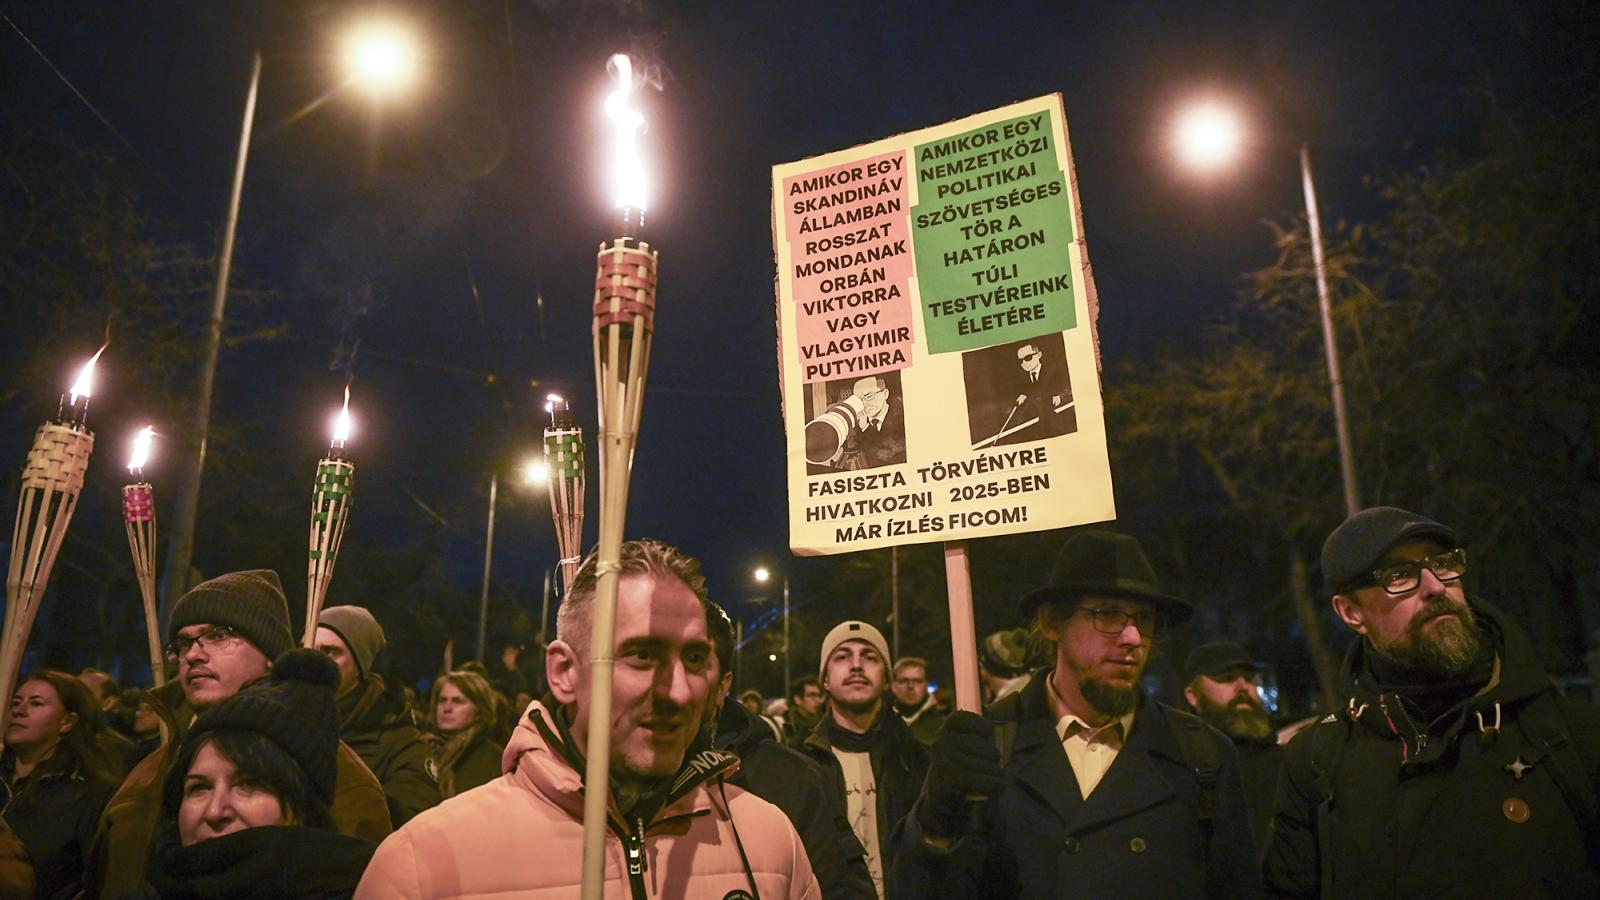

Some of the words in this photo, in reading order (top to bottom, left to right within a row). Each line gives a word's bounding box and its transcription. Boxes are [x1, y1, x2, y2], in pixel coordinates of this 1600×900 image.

[921, 129, 999, 162] AMIKOR
[1003, 115, 1042, 140] EGY
[790, 168, 863, 196] AMIKOR
[867, 156, 903, 177] EGY
[921, 136, 1048, 182] NEMZETKÖZI
[794, 177, 902, 214] SKANDINÁV
[938, 162, 1036, 198] POLITIKAI
[799, 198, 900, 234] ÁLLAMBAN
[917, 181, 1061, 228] SZÖVETSÉGES
[806, 223, 891, 255] ROSSZAT
[960, 219, 1003, 240] TÖR
[1008, 215, 1022, 230] A
[796, 240, 906, 278] MONDANAK
[944, 230, 1045, 267] HATÁRON
[820, 267, 885, 293] ORBÁN
[972, 264, 1018, 285] TÚLI
[803, 285, 901, 316] VIKTORRA
[928, 274, 1069, 317] TESTVÉREINK
[826, 310, 880, 333] VAGY
[958, 304, 1045, 336] ÉLETÉRE
[801, 327, 910, 359] VLAGYIMIR
[807, 349, 906, 380] PUTYINRA
[809, 472, 906, 497] FASISZTA
[917, 447, 1047, 483] TÖRVÉNYRE
[807, 492, 932, 522] HIVATKOZNI
[950, 474, 1049, 502] 2025-BEN
[836, 522, 881, 542] MÁR
[888, 515, 944, 536] ÍZLÉS
[949, 506, 1026, 529] FICOM!
